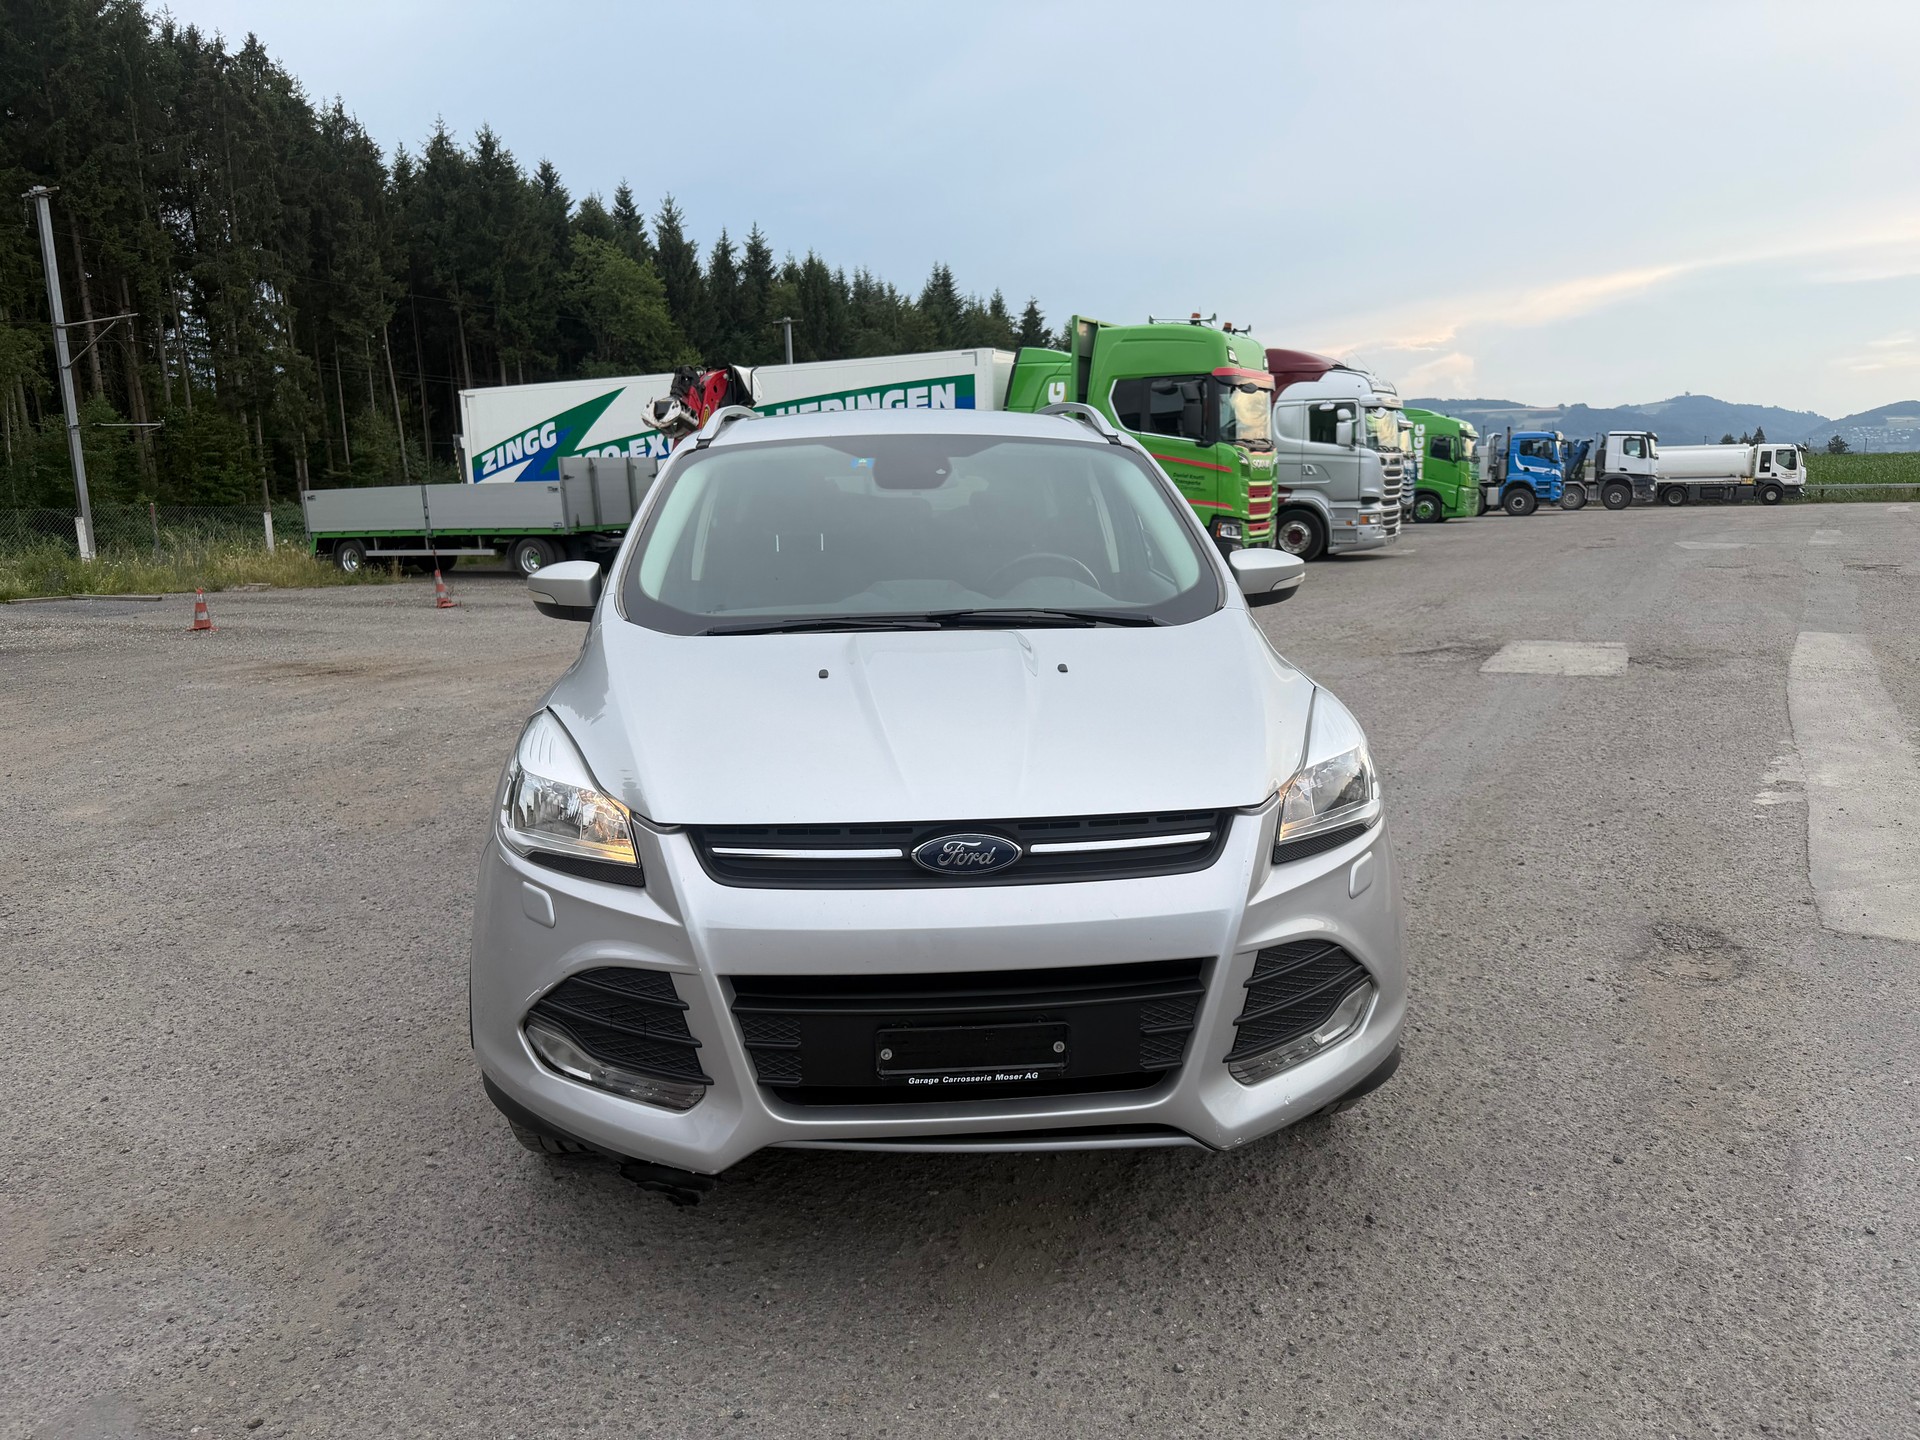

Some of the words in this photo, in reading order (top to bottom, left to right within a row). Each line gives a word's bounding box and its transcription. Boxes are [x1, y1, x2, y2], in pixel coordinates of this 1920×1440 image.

[481, 421, 557, 475] ZINGG
[937, 841, 996, 866] Ford
[908, 1077, 939, 1085] Garage
[942, 1074, 992, 1083] Carrosserie
[994, 1073, 1023, 1081] Moser
